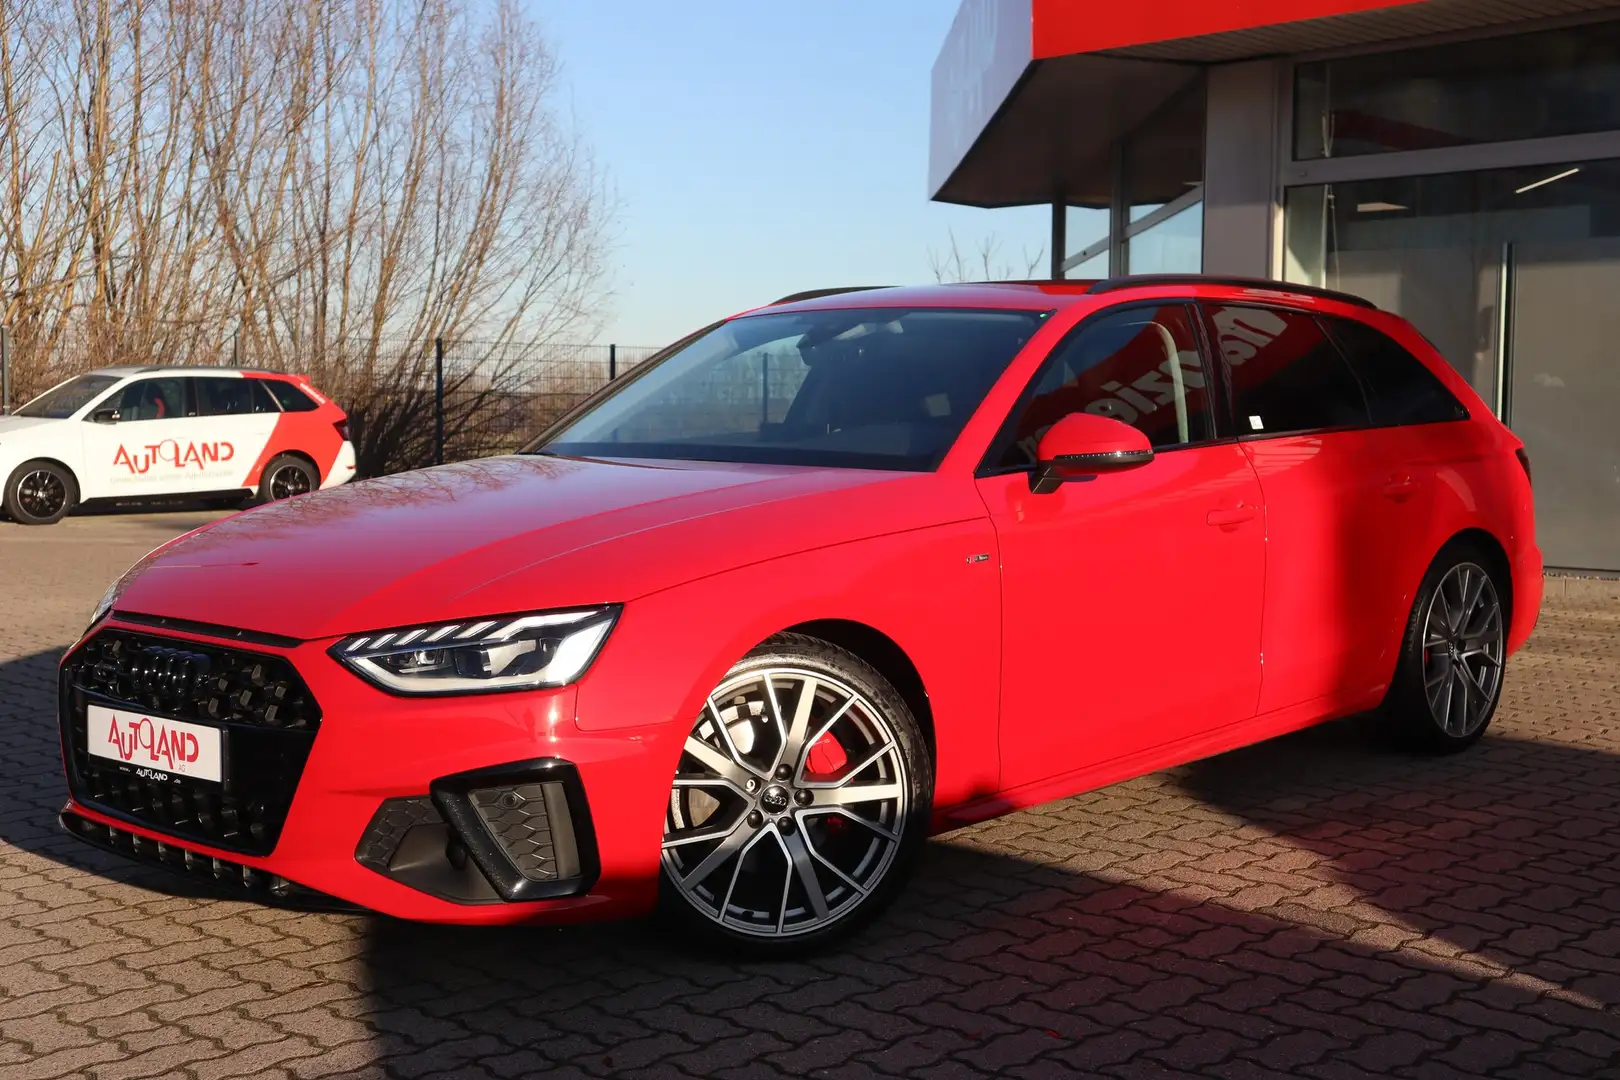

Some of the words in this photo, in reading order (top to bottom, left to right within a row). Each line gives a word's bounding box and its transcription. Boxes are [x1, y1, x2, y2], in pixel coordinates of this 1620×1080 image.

[113, 439, 234, 474] AUTOLAND
[108, 713, 199, 770] AUTOLAND
[136, 768, 168, 781] AUTOLAND
